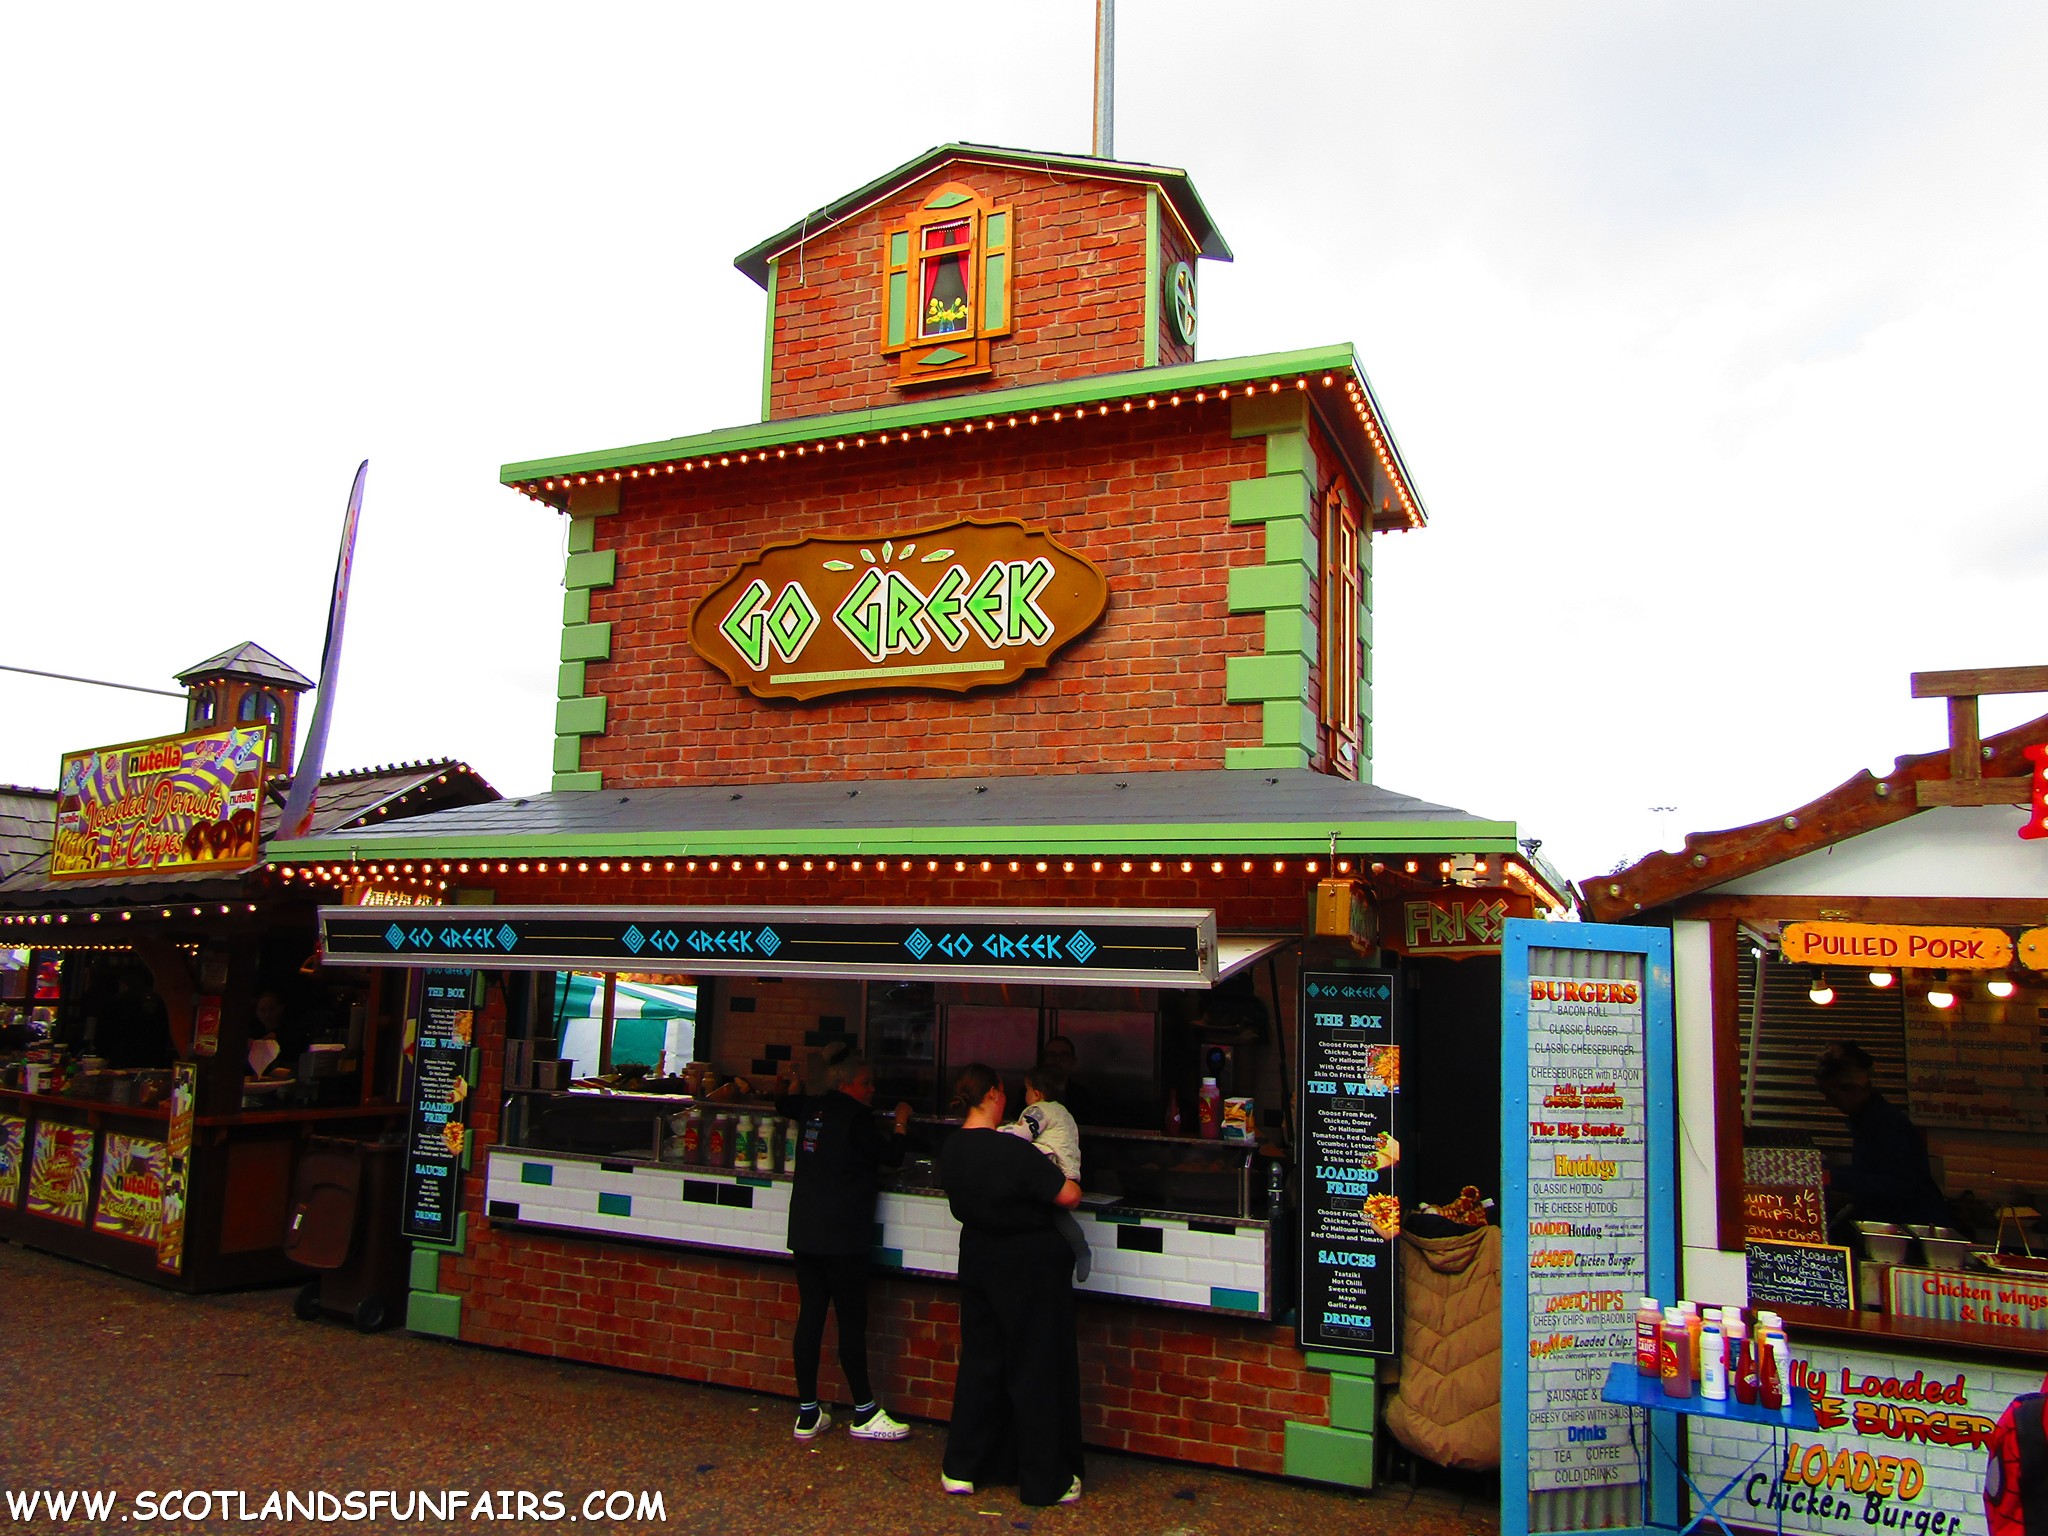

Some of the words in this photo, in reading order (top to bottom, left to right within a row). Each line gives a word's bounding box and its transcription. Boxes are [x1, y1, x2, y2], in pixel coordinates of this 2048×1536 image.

[718, 578, 820, 671] GO
[832, 556, 1056, 663] GREEK
[235, 732, 260, 768] OREO
[131, 746, 180, 773] nutella
[84, 780, 152, 841] Loaded
[150, 779, 222, 827] Donuts
[127, 820, 184, 870] Crepes
[1404, 898, 1509, 946] FRIES
[408, 928, 434, 947] GO
[440, 928, 495, 948] GREEK
[649, 929, 679, 952] GO
[686, 930, 754, 954] GREEK
[937, 933, 974, 958] GO
[981, 933, 1063, 960] GREEK
[1804, 933, 1898, 956] PULLED
[1910, 935, 1984, 960] PORK
[428, 987, 444, 997] THE
[447, 988, 465, 998] BOX
[1322, 985, 1338, 996] GO
[1341, 986, 1376, 998] GREEK
[1531, 980, 1638, 1004] BURGERS
[1558, 1006, 1586, 1016] BACON
[1588, 1007, 1608, 1017] ROLL
[1314, 1013, 1344, 1026] THE
[1350, 1015, 1382, 1028] BOX
[1550, 1024, 1584, 1035] CLASSIC
[1586, 1025, 1617, 1035] BURGER
[420, 1038, 436, 1048] THE
[1535, 1043, 1570, 1054] CLASSIC
[1572, 1044, 1634, 1055] CHEESEBURGER
[1324, 1048, 1351, 1056] Chicken,
[1532, 1068, 1593, 1079] CHEESEBURGER
[1596, 1070, 1610, 1079] with
[1613, 1069, 1639, 1080] BACON
[1308, 1081, 1337, 1094] THE
[1344, 1082, 1388, 1097] WRAP
[1554, 1083, 1576, 1096] Fully
[1580, 1083, 1616, 1094] Loaded
[420, 1101, 454, 1113] LOADED
[1543, 1096, 1582, 1108] CHEESE
[1584, 1096, 1624, 1109] BURGER
[424, 1112, 448, 1123] FRIES
[1312, 1132, 1345, 1140] Tomatoes,
[1530, 1122, 1555, 1136] The
[1558, 1123, 1580, 1138] Big
[1582, 1123, 1625, 1137] Smoke
[1317, 1140, 1349, 1149] Cucumber,
[416, 1164, 448, 1176] SAUCES
[1316, 1165, 1379, 1182] LOADED
[1554, 1154, 1617, 1180] Hotdogs
[1326, 1181, 1368, 1196] FRIES
[1533, 1183, 1567, 1194] CLASSIC
[1570, 1184, 1603, 1194] HOTDOG
[415, 1210, 441, 1221] DRINKS
[1342, 1210, 1358, 1218] From
[1534, 1203, 1549, 1213] THE
[1552, 1203, 1582, 1213] CHEESE
[1585, 1203, 1617, 1213] HOTDOG
[1750, 1205, 1793, 1220] Chips
[1323, 1217, 1351, 1225] Chicken,
[1530, 1222, 1569, 1236] LOADED
[1568, 1224, 1602, 1239] Hotdog
[1777, 1229, 1787, 1237] +
[1788, 1229, 1821, 1242] Chips
[1318, 1250, 1376, 1267] SAUCES
[1531, 1250, 1575, 1268] LOADED
[1574, 1253, 1605, 1267] Chicken
[1608, 1253, 1635, 1269] Burger
[1802, 1249, 1839, 1263] Loaded
[1801, 1258, 1830, 1272] Bacon
[1773, 1272, 1807, 1286] Loaded
[1923, 1273, 1992, 1300] Chicken
[1998, 1289, 2048, 1311] wings
[1328, 1301, 1347, 1309] Garlic
[1545, 1293, 1580, 1312] LOADED
[1579, 1290, 1624, 1311] CHIPS
[1323, 1312, 1372, 1327] DRINKS
[1534, 1314, 1560, 1326] CHEESY
[1562, 1314, 1584, 1326] CHIPS
[1586, 1315, 1600, 1324] with
[1601, 1313, 1625, 1324] BACON
[1960, 1305, 1976, 1320] &
[1983, 1306, 2020, 1326] fries
[1574, 1336, 1605, 1349] Loaded
[1609, 1334, 1633, 1349] Chips
[1575, 1369, 1601, 1381] CHIPS
[1547, 1388, 1589, 1402] SAUSAGE
[1592, 1389, 1597, 1400] &
[1842, 1371, 1967, 1406] Loaded
[1530, 1410, 1559, 1423] CHEESY
[1562, 1410, 1585, 1422] CHIPS
[1587, 1410, 1607, 1421] WITH
[1854, 1402, 2000, 1450] BURGER
[1568, 1426, 1607, 1442] Drinks
[1555, 1451, 1572, 1463] TEA
[1586, 1448, 1620, 1460] COFFEE
[1555, 1470, 1581, 1483] COLD
[1584, 1467, 1618, 1481] DRINKS
[1782, 1443, 1924, 1500] LOADED
[1746, 1473, 1851, 1521] Chicken
[1863, 1491, 1960, 1536] Burger
